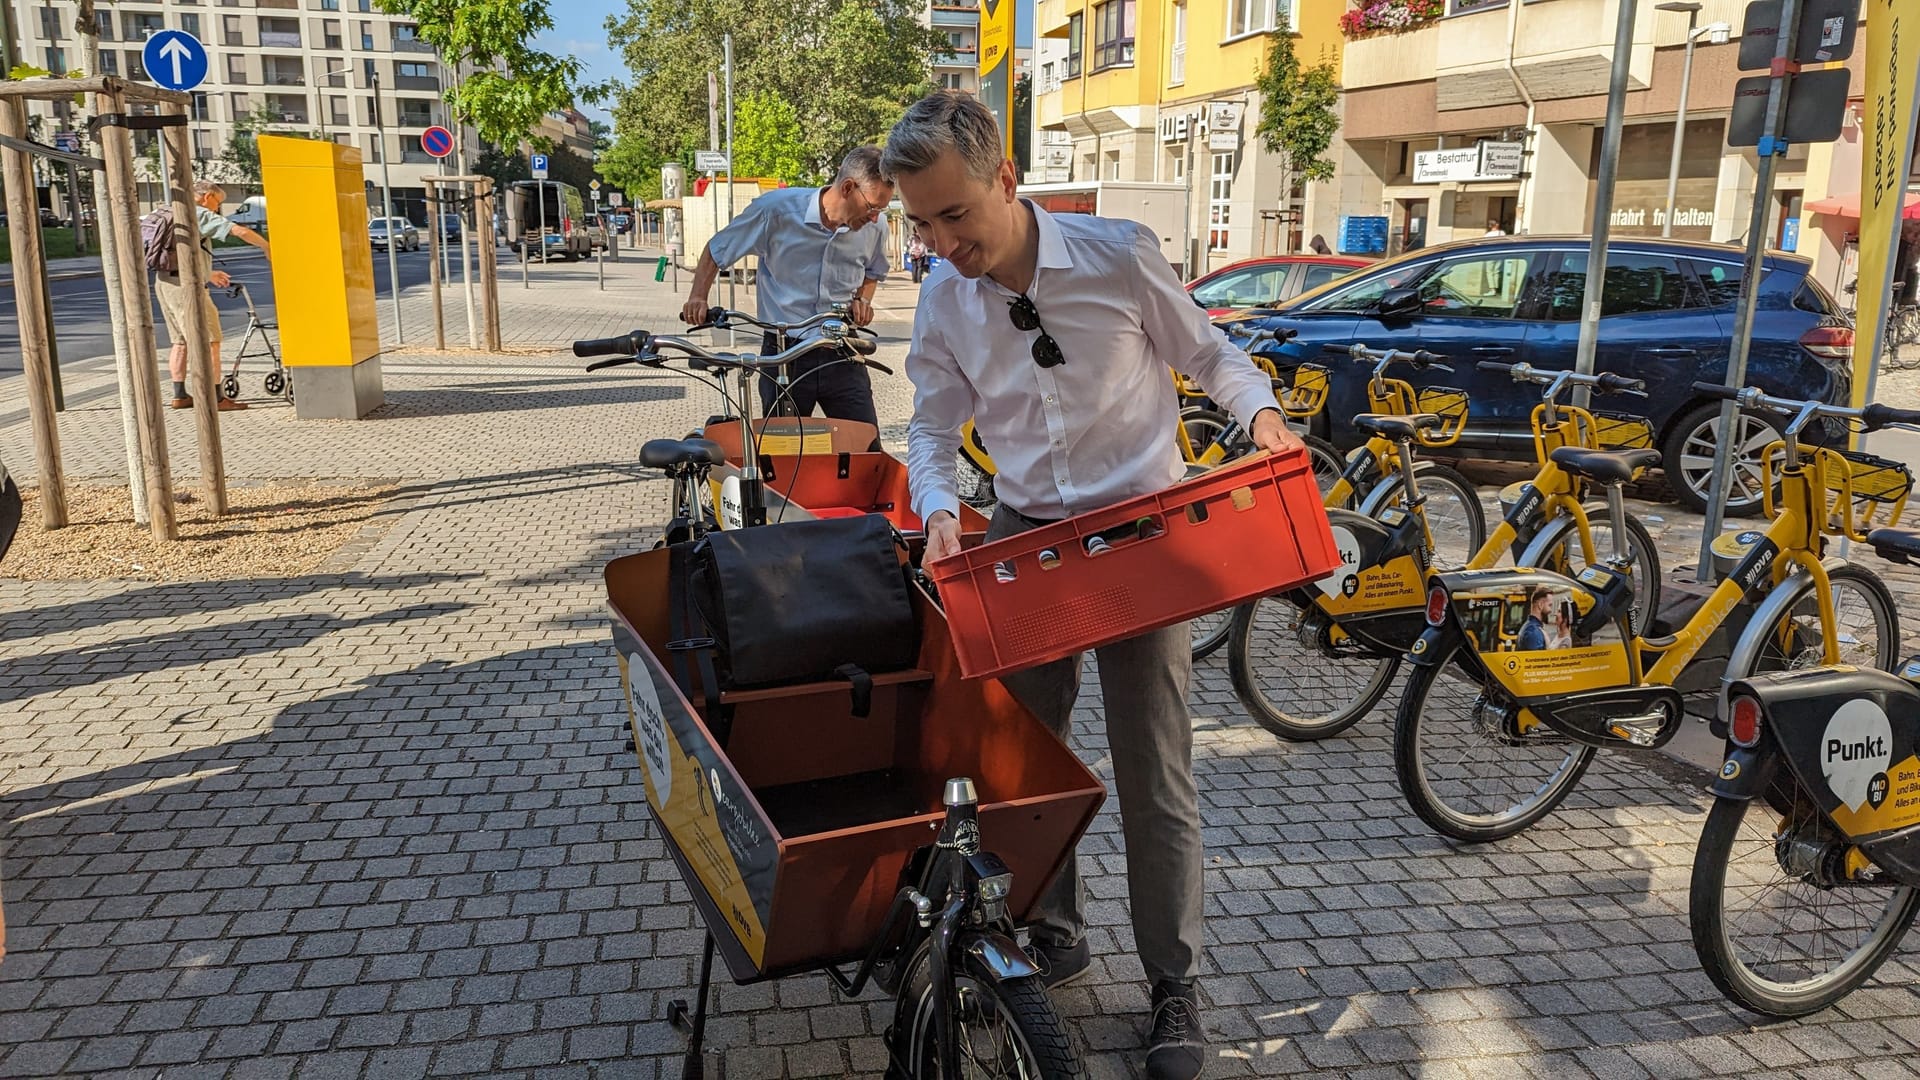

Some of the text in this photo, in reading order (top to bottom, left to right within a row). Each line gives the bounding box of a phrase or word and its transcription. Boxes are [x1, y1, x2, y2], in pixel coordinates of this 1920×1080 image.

[534, 157, 544, 169] P
[1673, 207, 1713, 226] halten
[722, 496, 737, 512] Fahr
[1339, 549, 1357, 564] kt.
[1364, 591, 1377, 599] Alles
[1827, 735, 1888, 763] Punkt.
[1871, 779, 1886, 792] MO
[1896, 784, 1910, 795] und
[1873, 791, 1882, 802] BI
[1895, 798, 1910, 809] Alles
[1910, 797, 1919, 805] an
